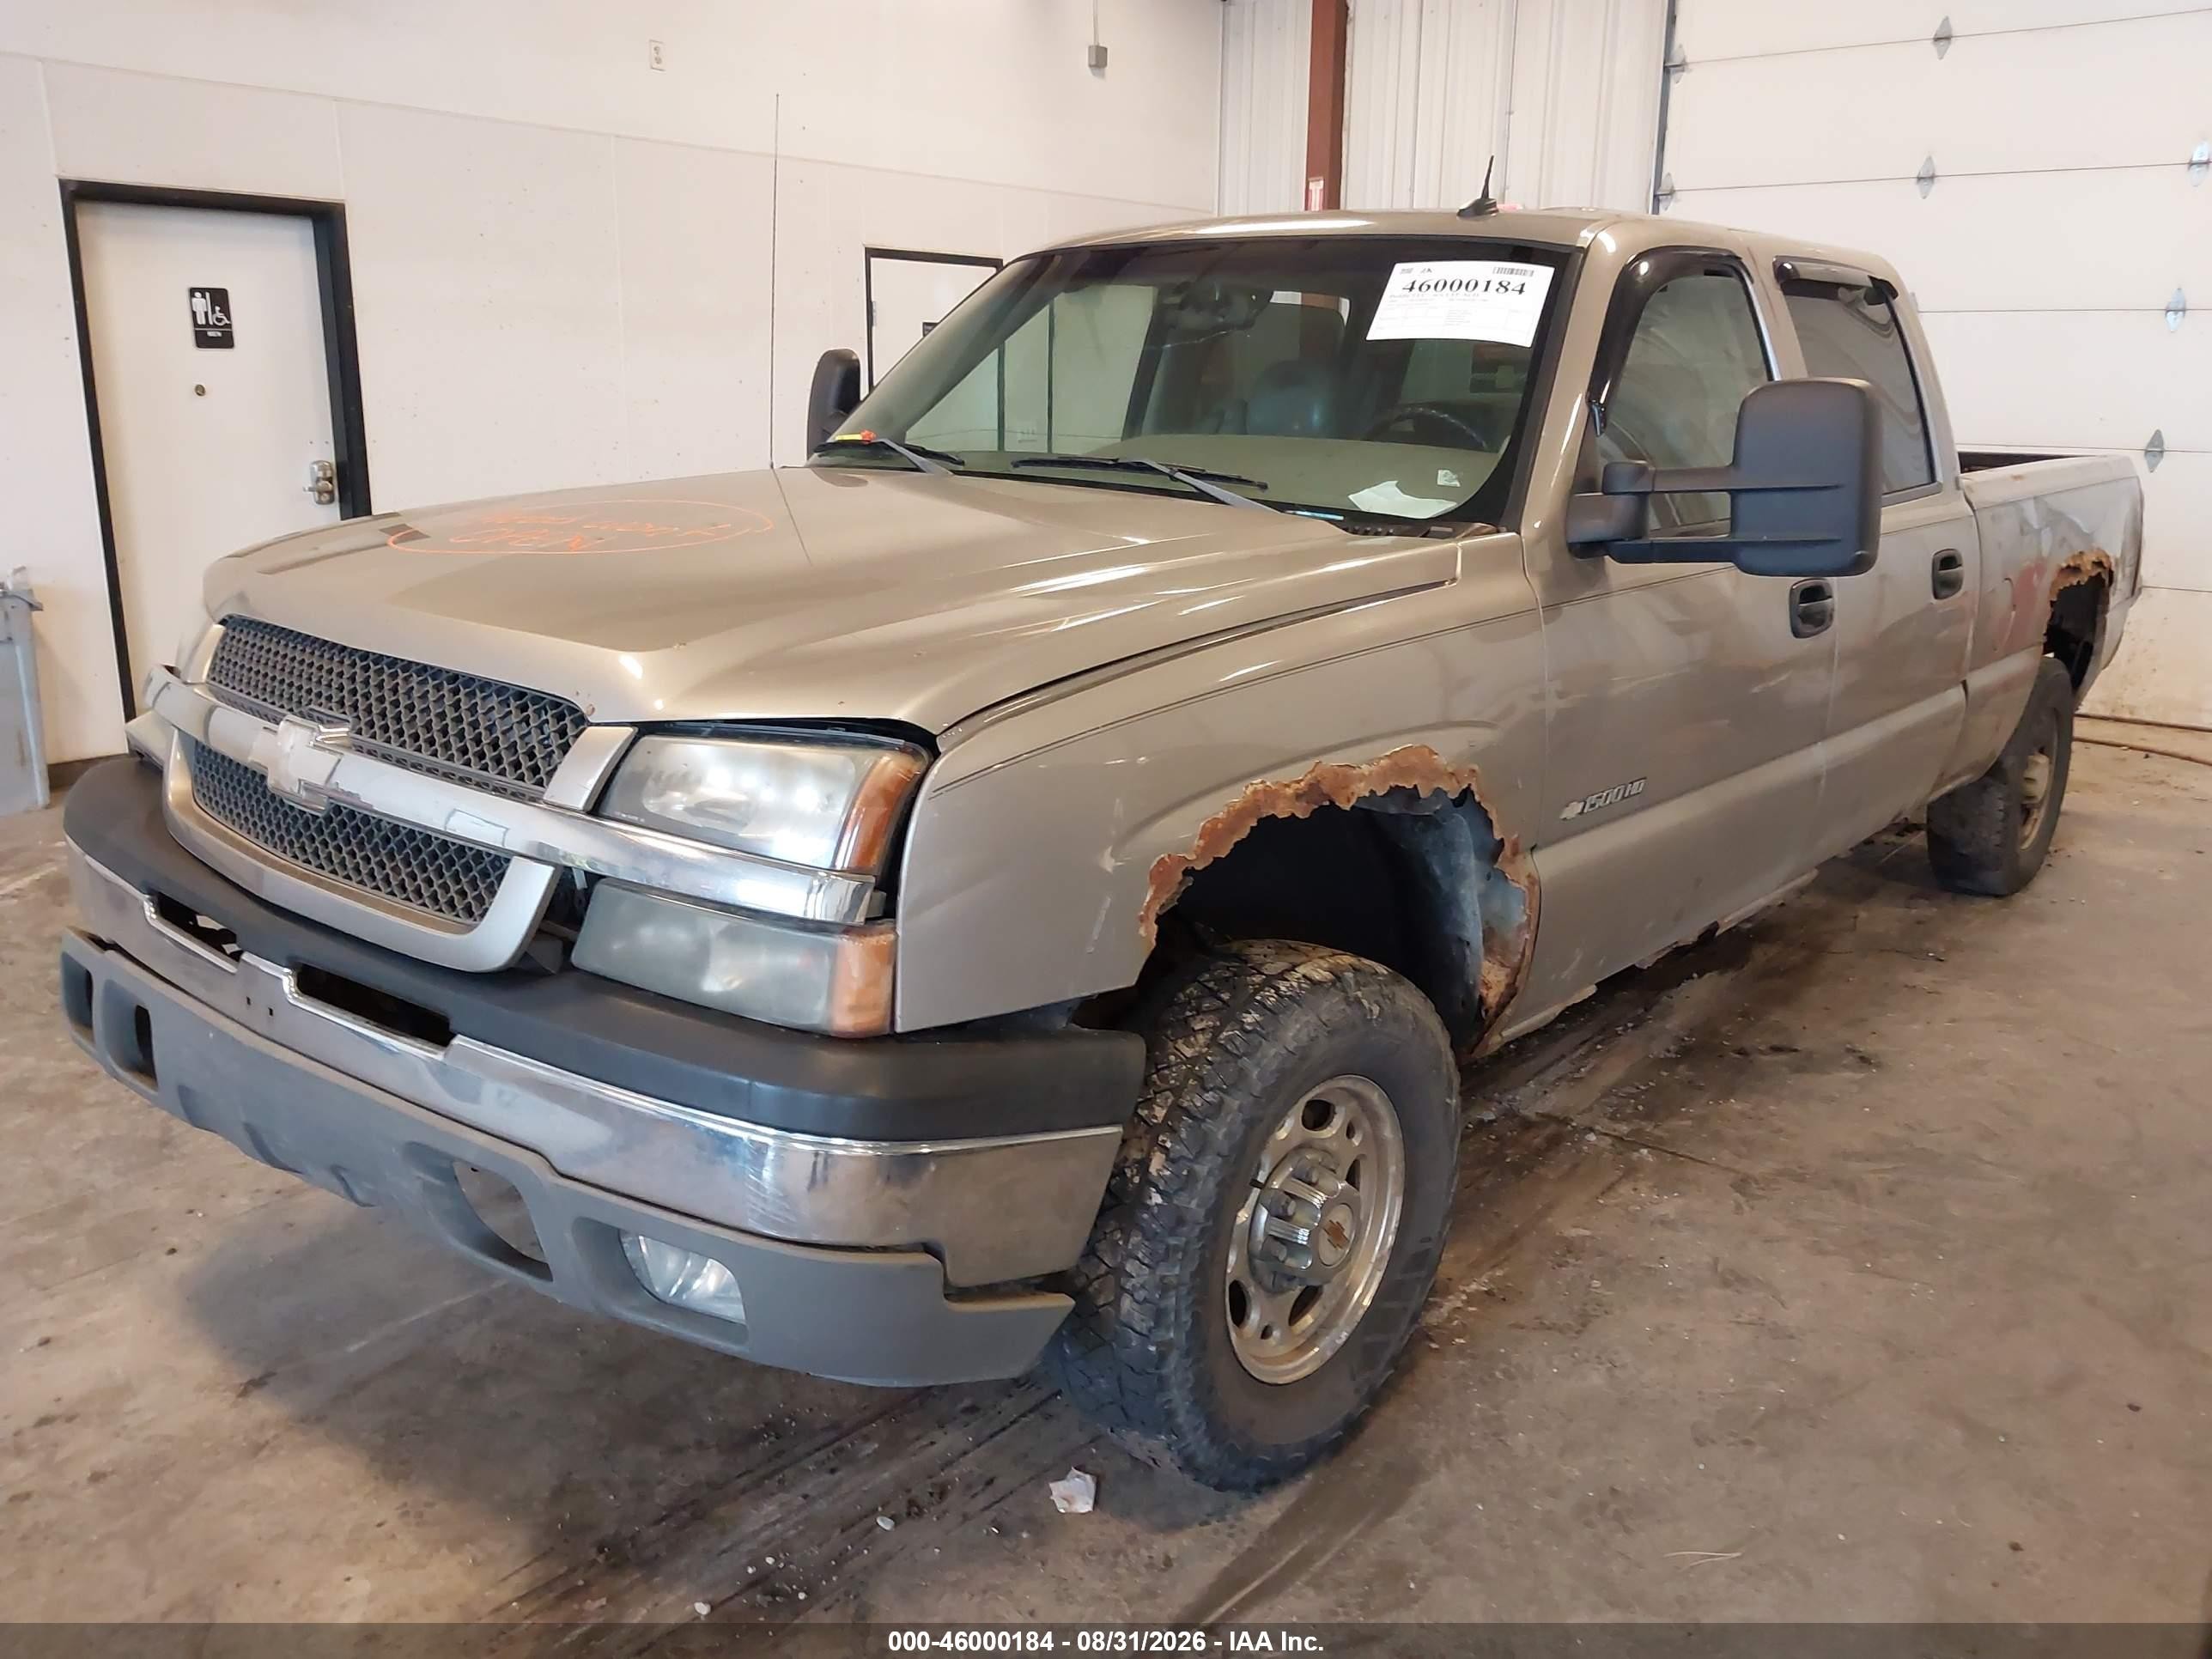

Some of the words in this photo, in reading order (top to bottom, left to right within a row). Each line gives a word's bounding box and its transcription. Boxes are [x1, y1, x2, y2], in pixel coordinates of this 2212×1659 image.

[1401, 278, 1527, 296] 46000184
[1583, 785, 1626, 813] 1500
[1625, 778, 1646, 798] HD
